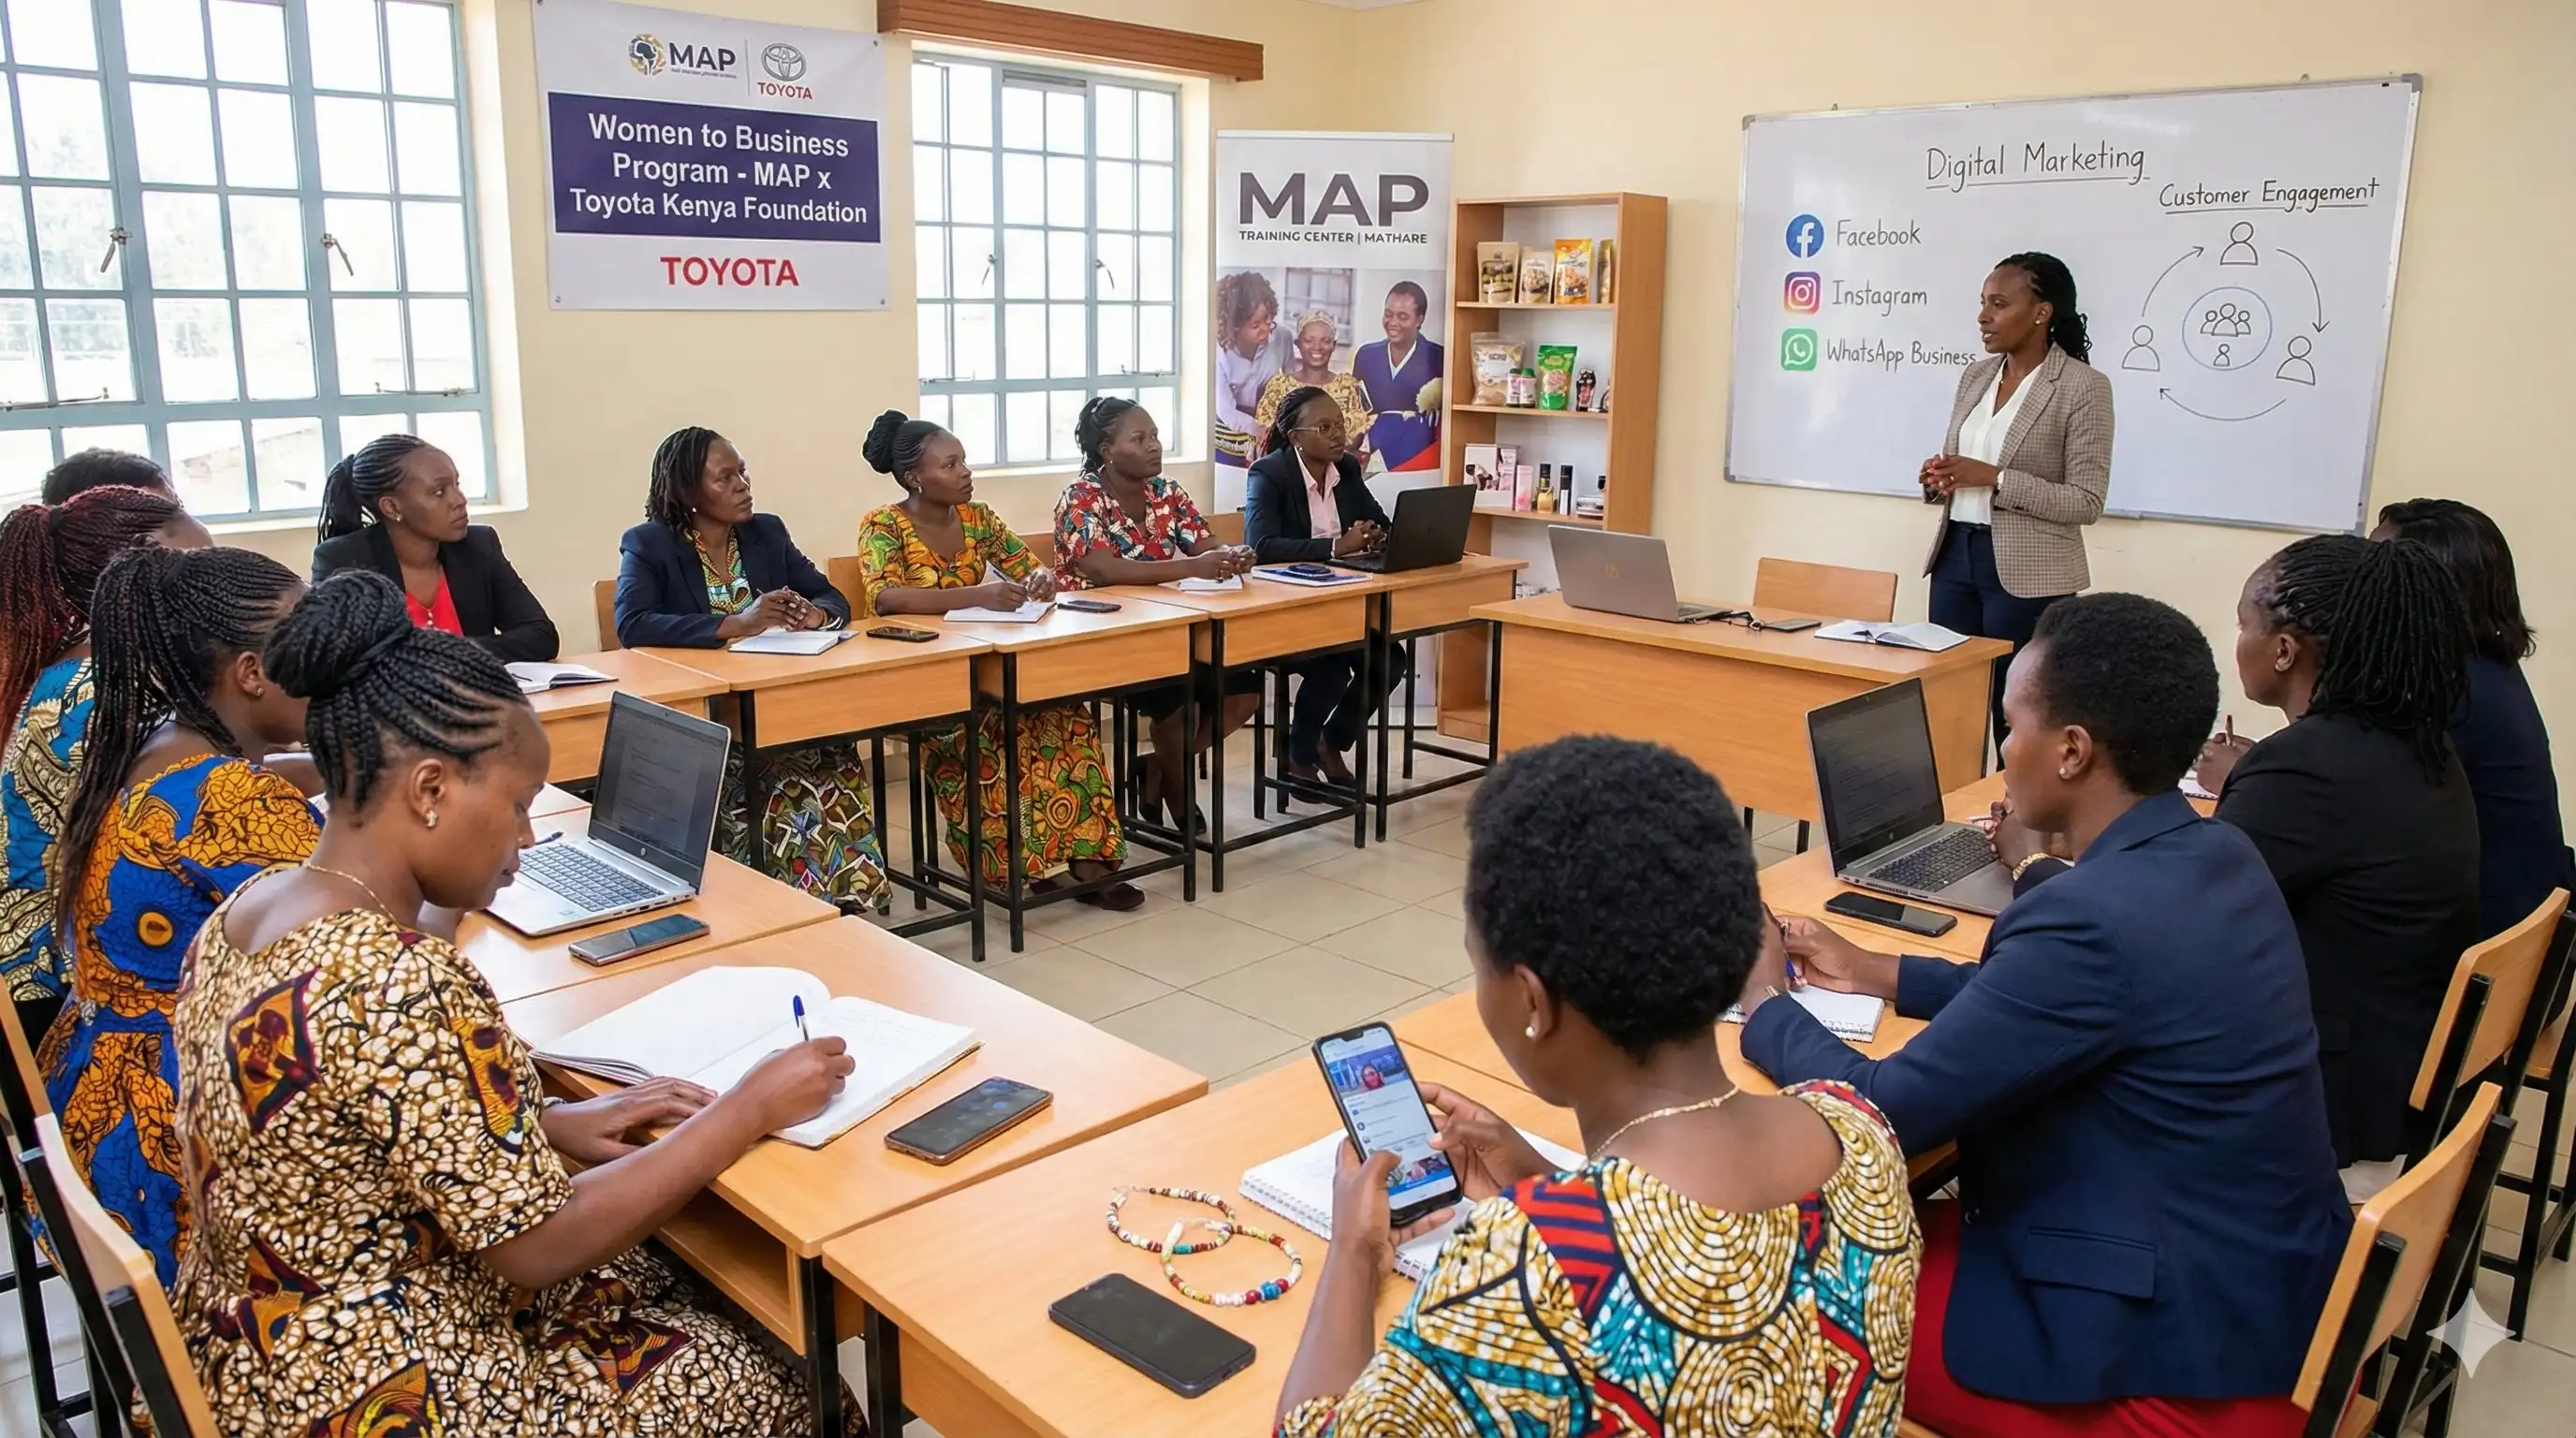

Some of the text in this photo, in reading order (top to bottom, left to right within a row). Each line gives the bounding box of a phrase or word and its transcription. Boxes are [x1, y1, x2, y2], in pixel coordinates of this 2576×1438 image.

[668, 42, 737, 71] MAP
[757, 82, 812, 100] TOYOTA
[588, 112, 849, 157] Women to Business
[613, 152, 728, 187] Program
[754, 162, 811, 189] MAP
[817, 171, 832, 189] x
[1926, 139, 2144, 193] Digital Marketing
[569, 187, 868, 224] Toyota Kenya Foundation
[1239, 172, 1429, 227] MAP
[2159, 177, 2380, 213] Customer Engagement
[1238, 230, 1300, 242] TRAINING
[1304, 231, 1354, 242] CENTER
[1364, 233, 1427, 243] MATHARE
[1837, 218, 1922, 247] Facebook
[660, 257, 799, 286] TOYOTA
[1832, 279, 1927, 317] Instagram
[1826, 338, 1977, 373] WhatsApp Business
